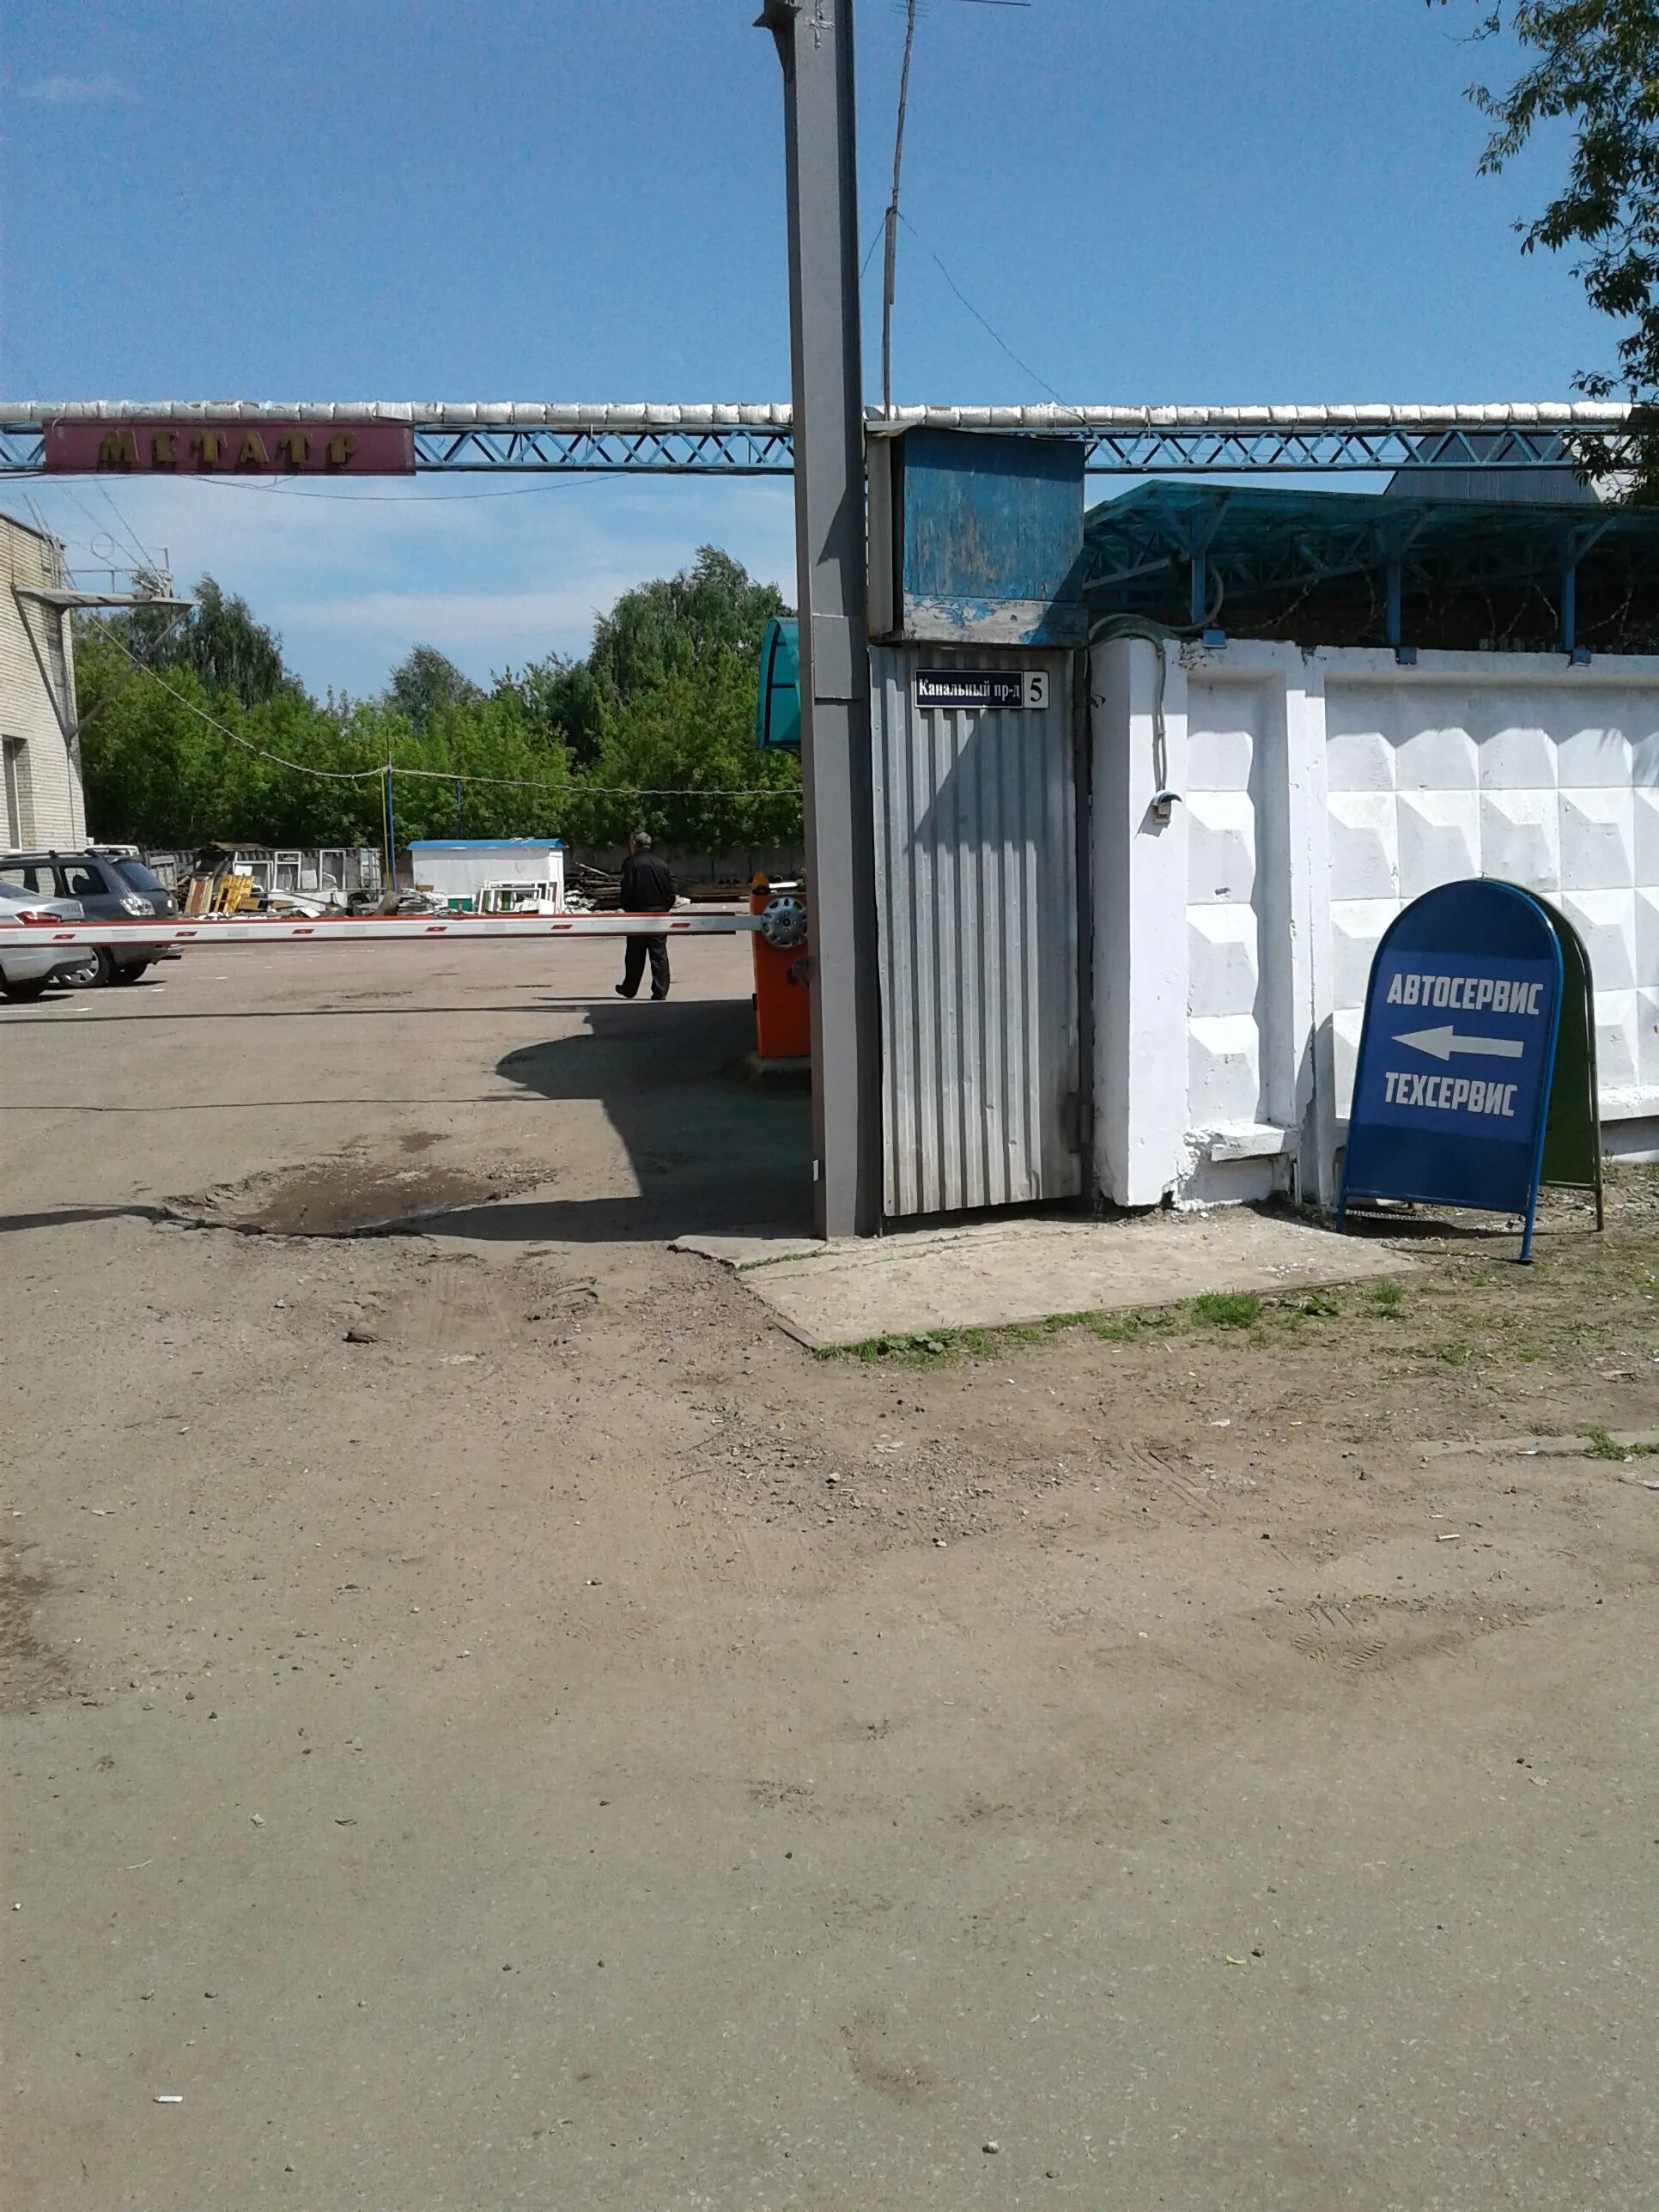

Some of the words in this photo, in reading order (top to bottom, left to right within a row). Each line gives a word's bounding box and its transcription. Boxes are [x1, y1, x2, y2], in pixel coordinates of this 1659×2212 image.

[919, 678, 990, 696] Канальный
[994, 684, 1021, 702] пр-д
[1030, 678, 1042, 702] 5
[1387, 973, 1544, 1015] АВТОСЕРВИС
[1385, 1072, 1518, 1116] ТЕХСЕРВИС
